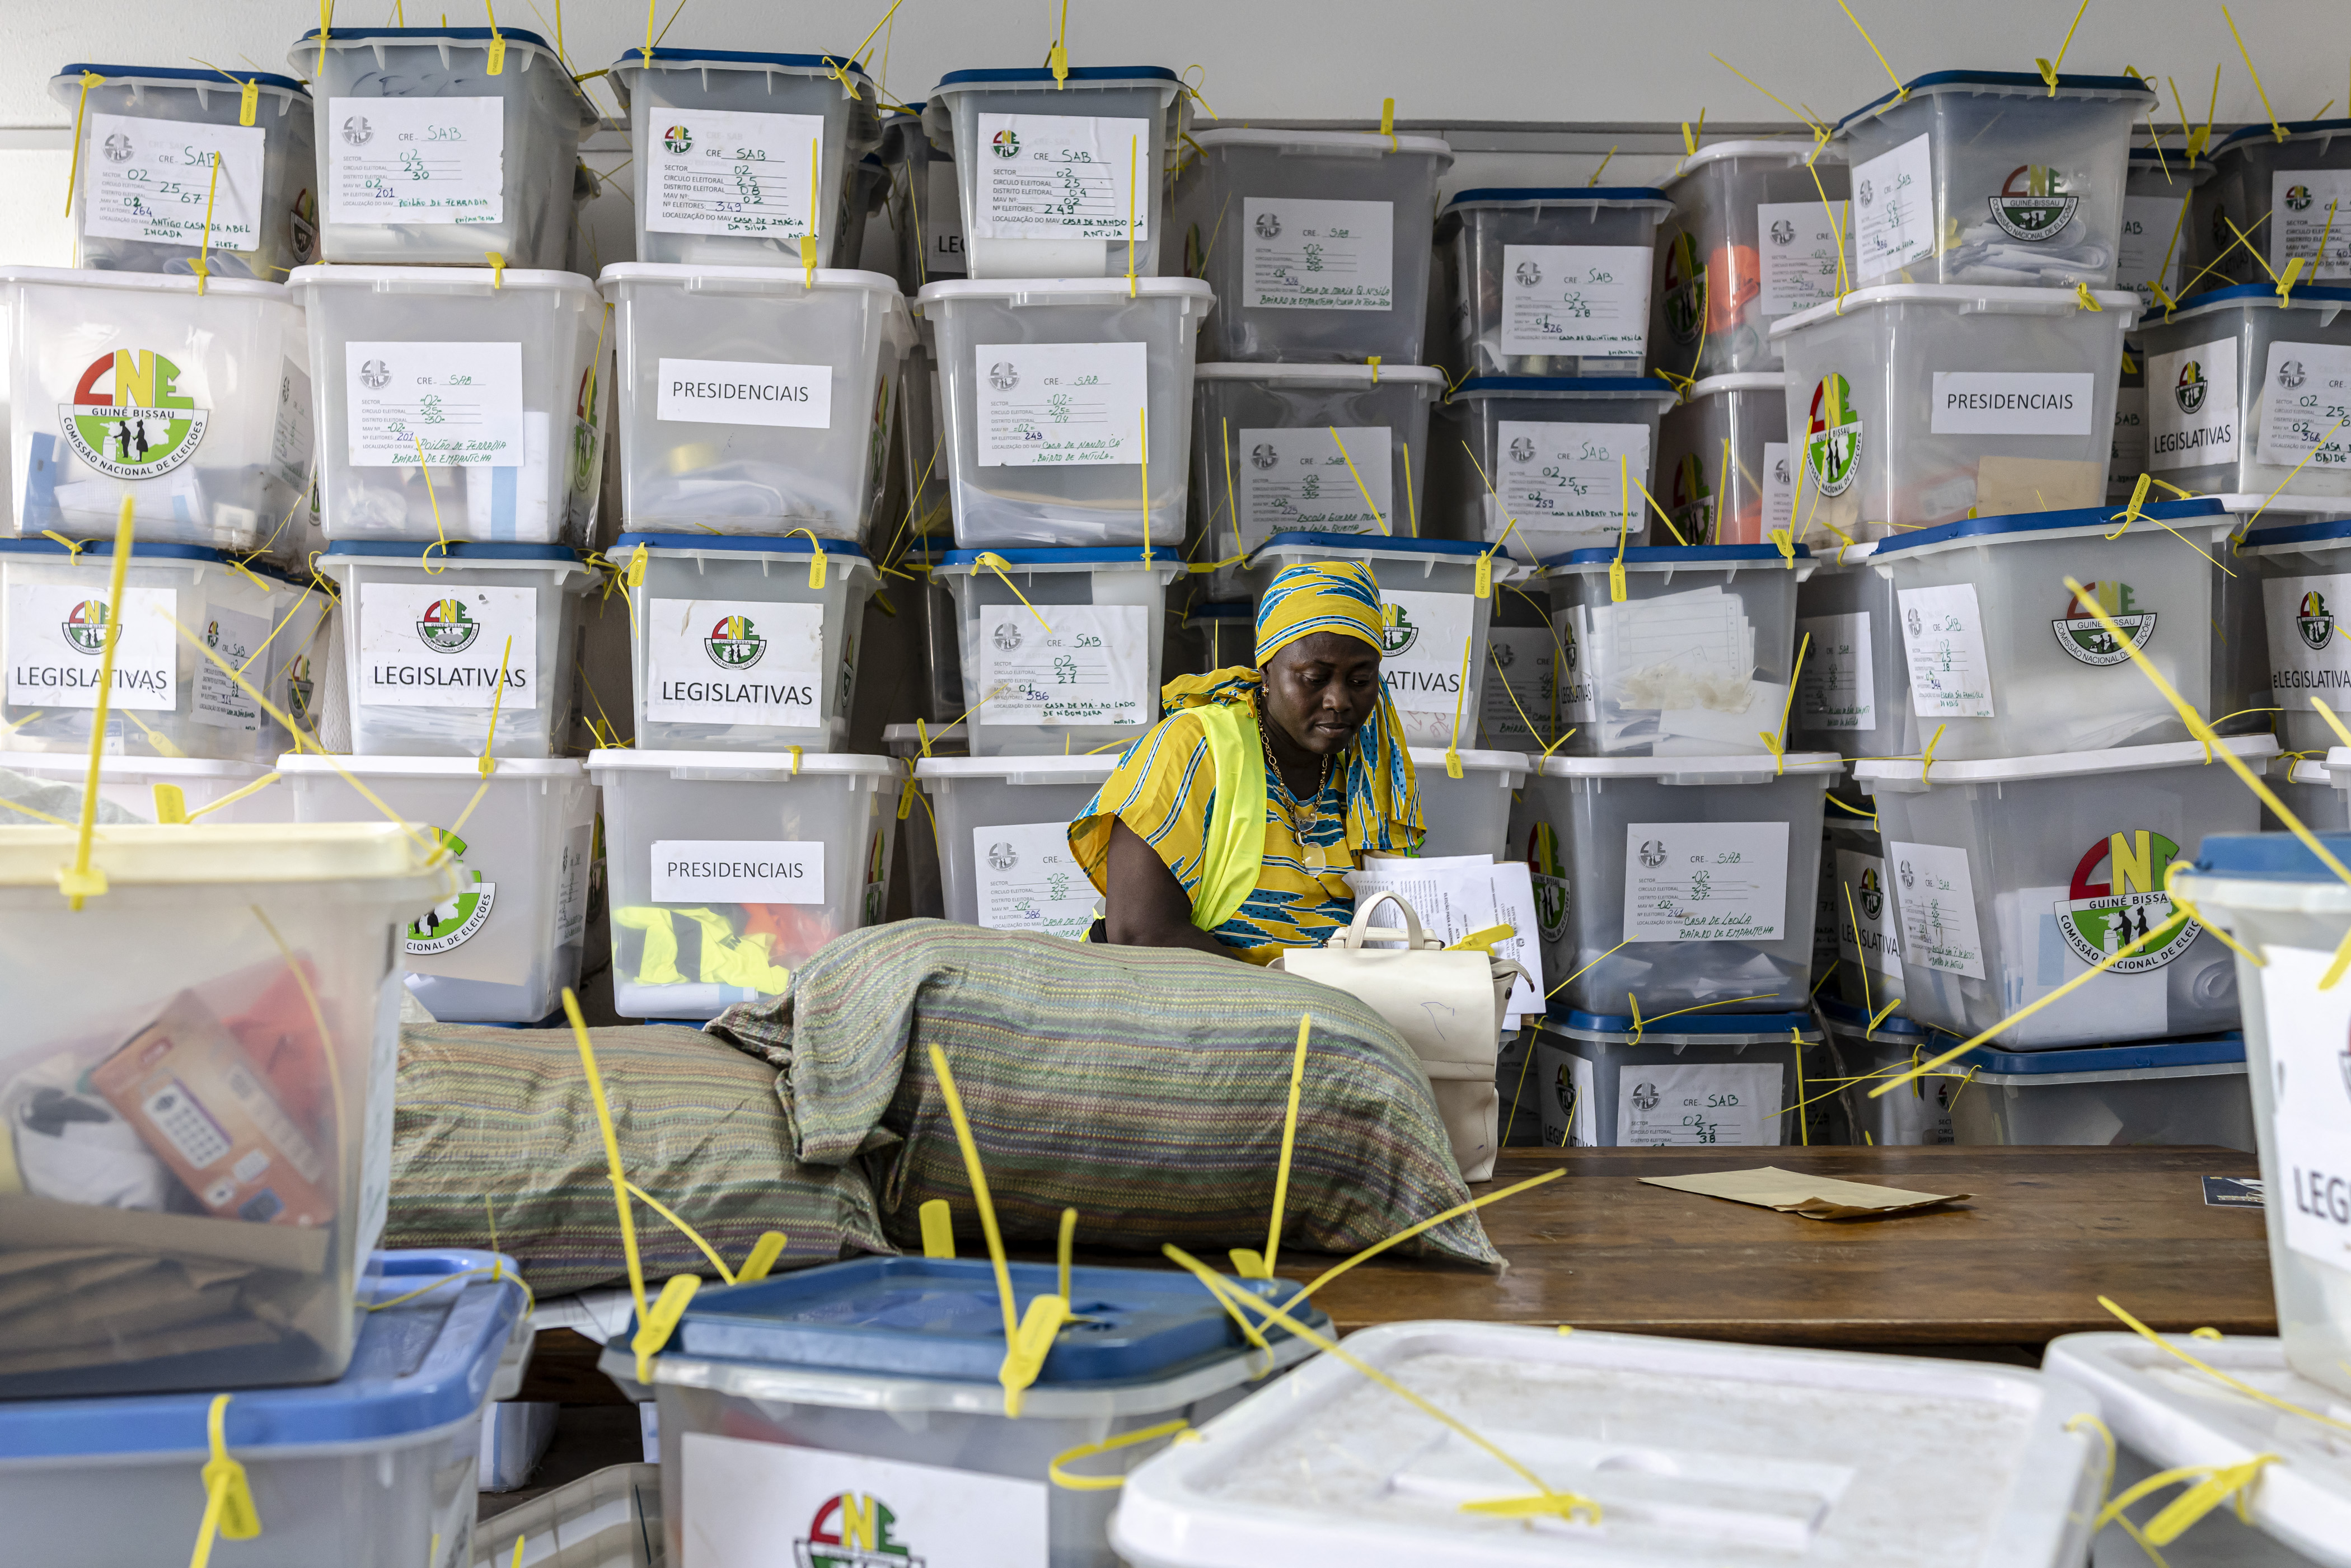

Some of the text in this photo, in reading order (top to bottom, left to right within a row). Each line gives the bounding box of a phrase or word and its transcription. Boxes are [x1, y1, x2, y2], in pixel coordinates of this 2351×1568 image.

[428, 125, 462, 140] SAB
[736, 148, 766, 161] SAB
[1062, 149, 1091, 162] SAB
[404, 161, 423, 171] 25
[734, 166, 752, 175] 02
[1057, 168, 1074, 177] 02
[736, 177, 756, 186] 25
[1065, 179, 1080, 188] 25
[2001, 164, 2068, 196] CNE
[181, 193, 202, 204] 67
[376, 188, 395, 198] 201
[1070, 189, 1086, 198] 04
[133, 207, 152, 217] 264
[715, 202, 742, 212] 349
[1045, 204, 1074, 215] 249
[663, 212, 704, 221] LOCALIZAÇÃO
[992, 216, 1033, 224] LOCALIZAÇÃO
[1992, 199, 2012, 232] COMISSÃO
[2012, 228, 2044, 239] NACIONAL
[2054, 198, 2074, 230] ELEIÇÕES
[1587, 268, 1613, 283] SAB
[73, 348, 194, 409] CNE
[449, 375, 471, 385] SAB
[673, 381, 809, 402] PRESIDENCIAIS
[1810, 373, 1857, 434] CNE
[1947, 393, 2074, 410] PRESIDENCIAIS
[2300, 395, 2318, 407] 02
[92, 406, 175, 418] GUINÉ BISSAU
[2326, 406, 2345, 417] 25
[397, 433, 414, 441] 201
[1833, 427, 1850, 437] BISSAU
[2155, 424, 2231, 454] LEGISLATIVAS
[64, 418, 203, 476] COMISSÃO NACIONAL DE ELEIÇÕES
[1580, 442, 1609, 461] SAB
[425, 453, 436, 463] DE
[1821, 432, 1861, 493] NACIONAL DE ELEIÇÕES
[424, 599, 472, 623] CNE
[711, 616, 760, 640] CNE
[1945, 615, 1961, 631] SAB
[463, 629, 476, 647] ELEIÇÕES
[1074, 634, 1102, 648] SAB
[2057, 622, 2082, 657] COMISSÃO
[2082, 654, 2120, 664] NACIONAL
[707, 644, 722, 663] COMISSÃO
[750, 645, 764, 663] ELEIÇÕES
[17, 667, 167, 689] LEGISLATIVAS
[374, 666, 526, 687] LEGISLATIVAS
[1055, 666, 1077, 676] 25
[1385, 671, 1459, 692] ATIVAS
[663, 681, 812, 705] LEGISLATIVAS
[1717, 853, 1741, 864] SAB
[668, 862, 804, 878] PRESIDENCIAIS
[2089, 895, 2127, 909] GUINÉ
[1024, 910, 1041, 919] 386
[1684, 916, 1720, 925] CASA DE
[406, 894, 490, 951] CIONAL DE ELEIÇÕES
[1714, 929, 1724, 938] DE
[1842, 924, 1901, 957] LEGISLATIVA
[2061, 915, 2175, 969] COMISSÃO NACIONAL DE
[1707, 1094, 1739, 1108] SAB
[1683, 1115, 1706, 1126] 02
